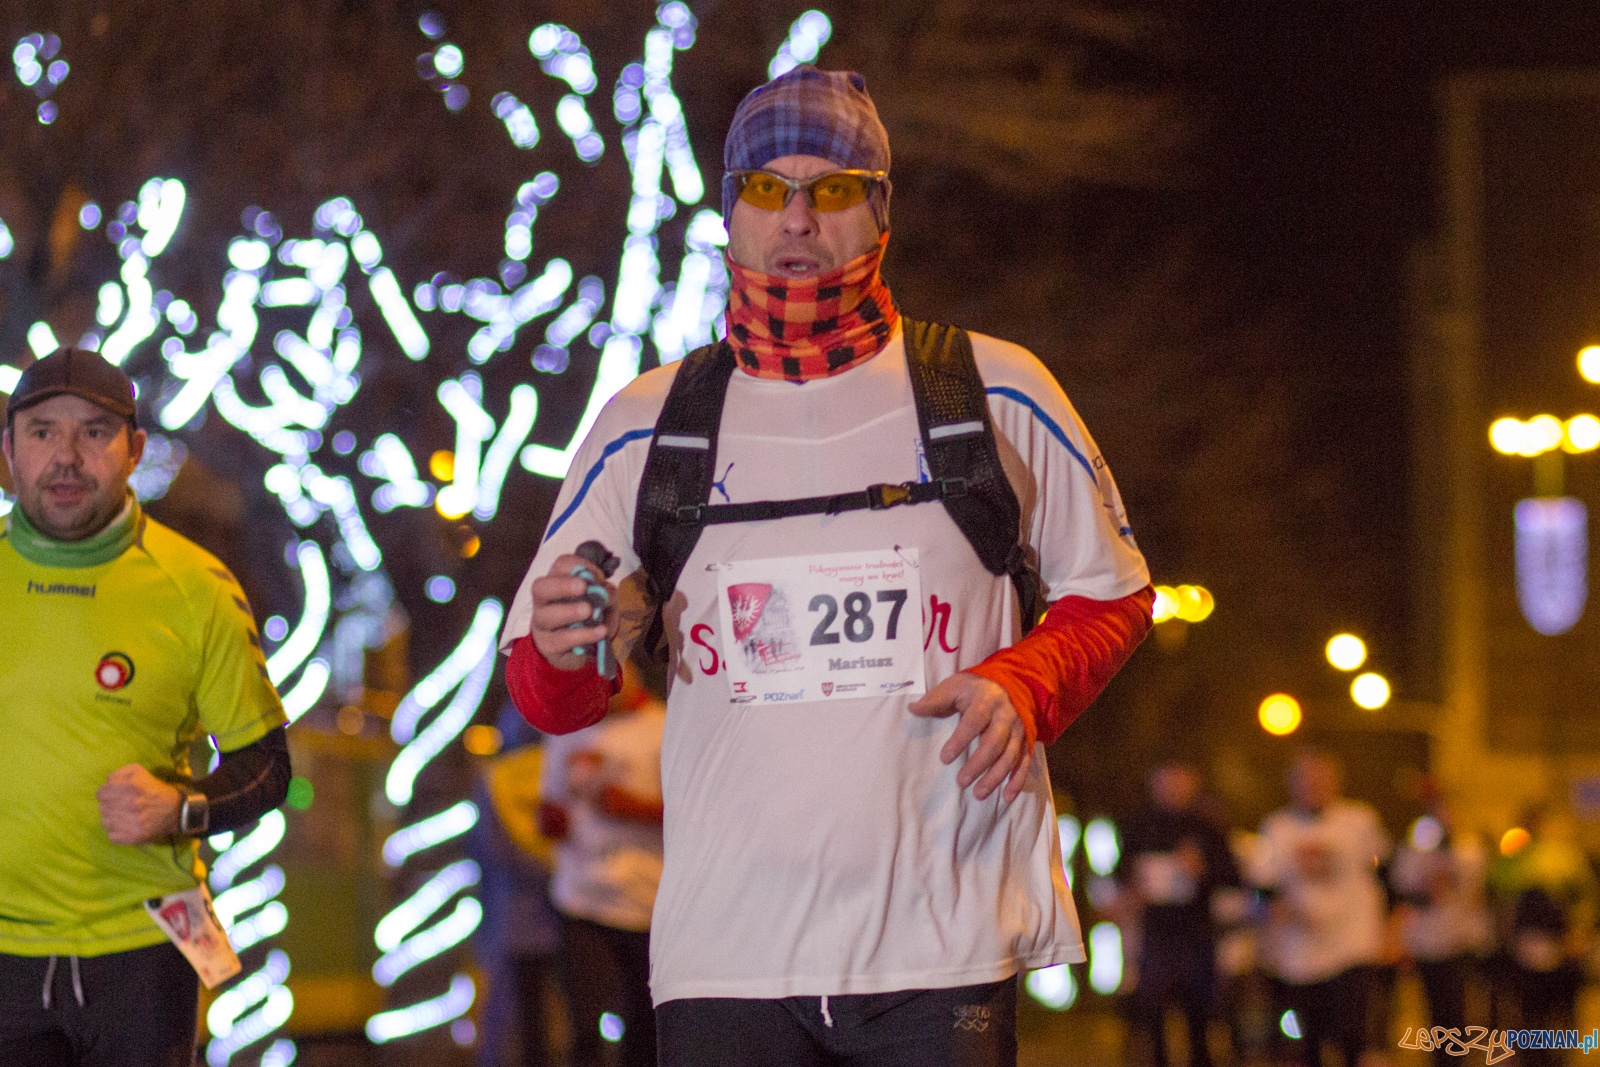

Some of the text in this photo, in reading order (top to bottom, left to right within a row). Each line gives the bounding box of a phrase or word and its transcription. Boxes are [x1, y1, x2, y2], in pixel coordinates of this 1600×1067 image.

[27, 579, 97, 598] hummel
[807, 588, 908, 646] 287
[828, 655, 894, 672] Mariusz
